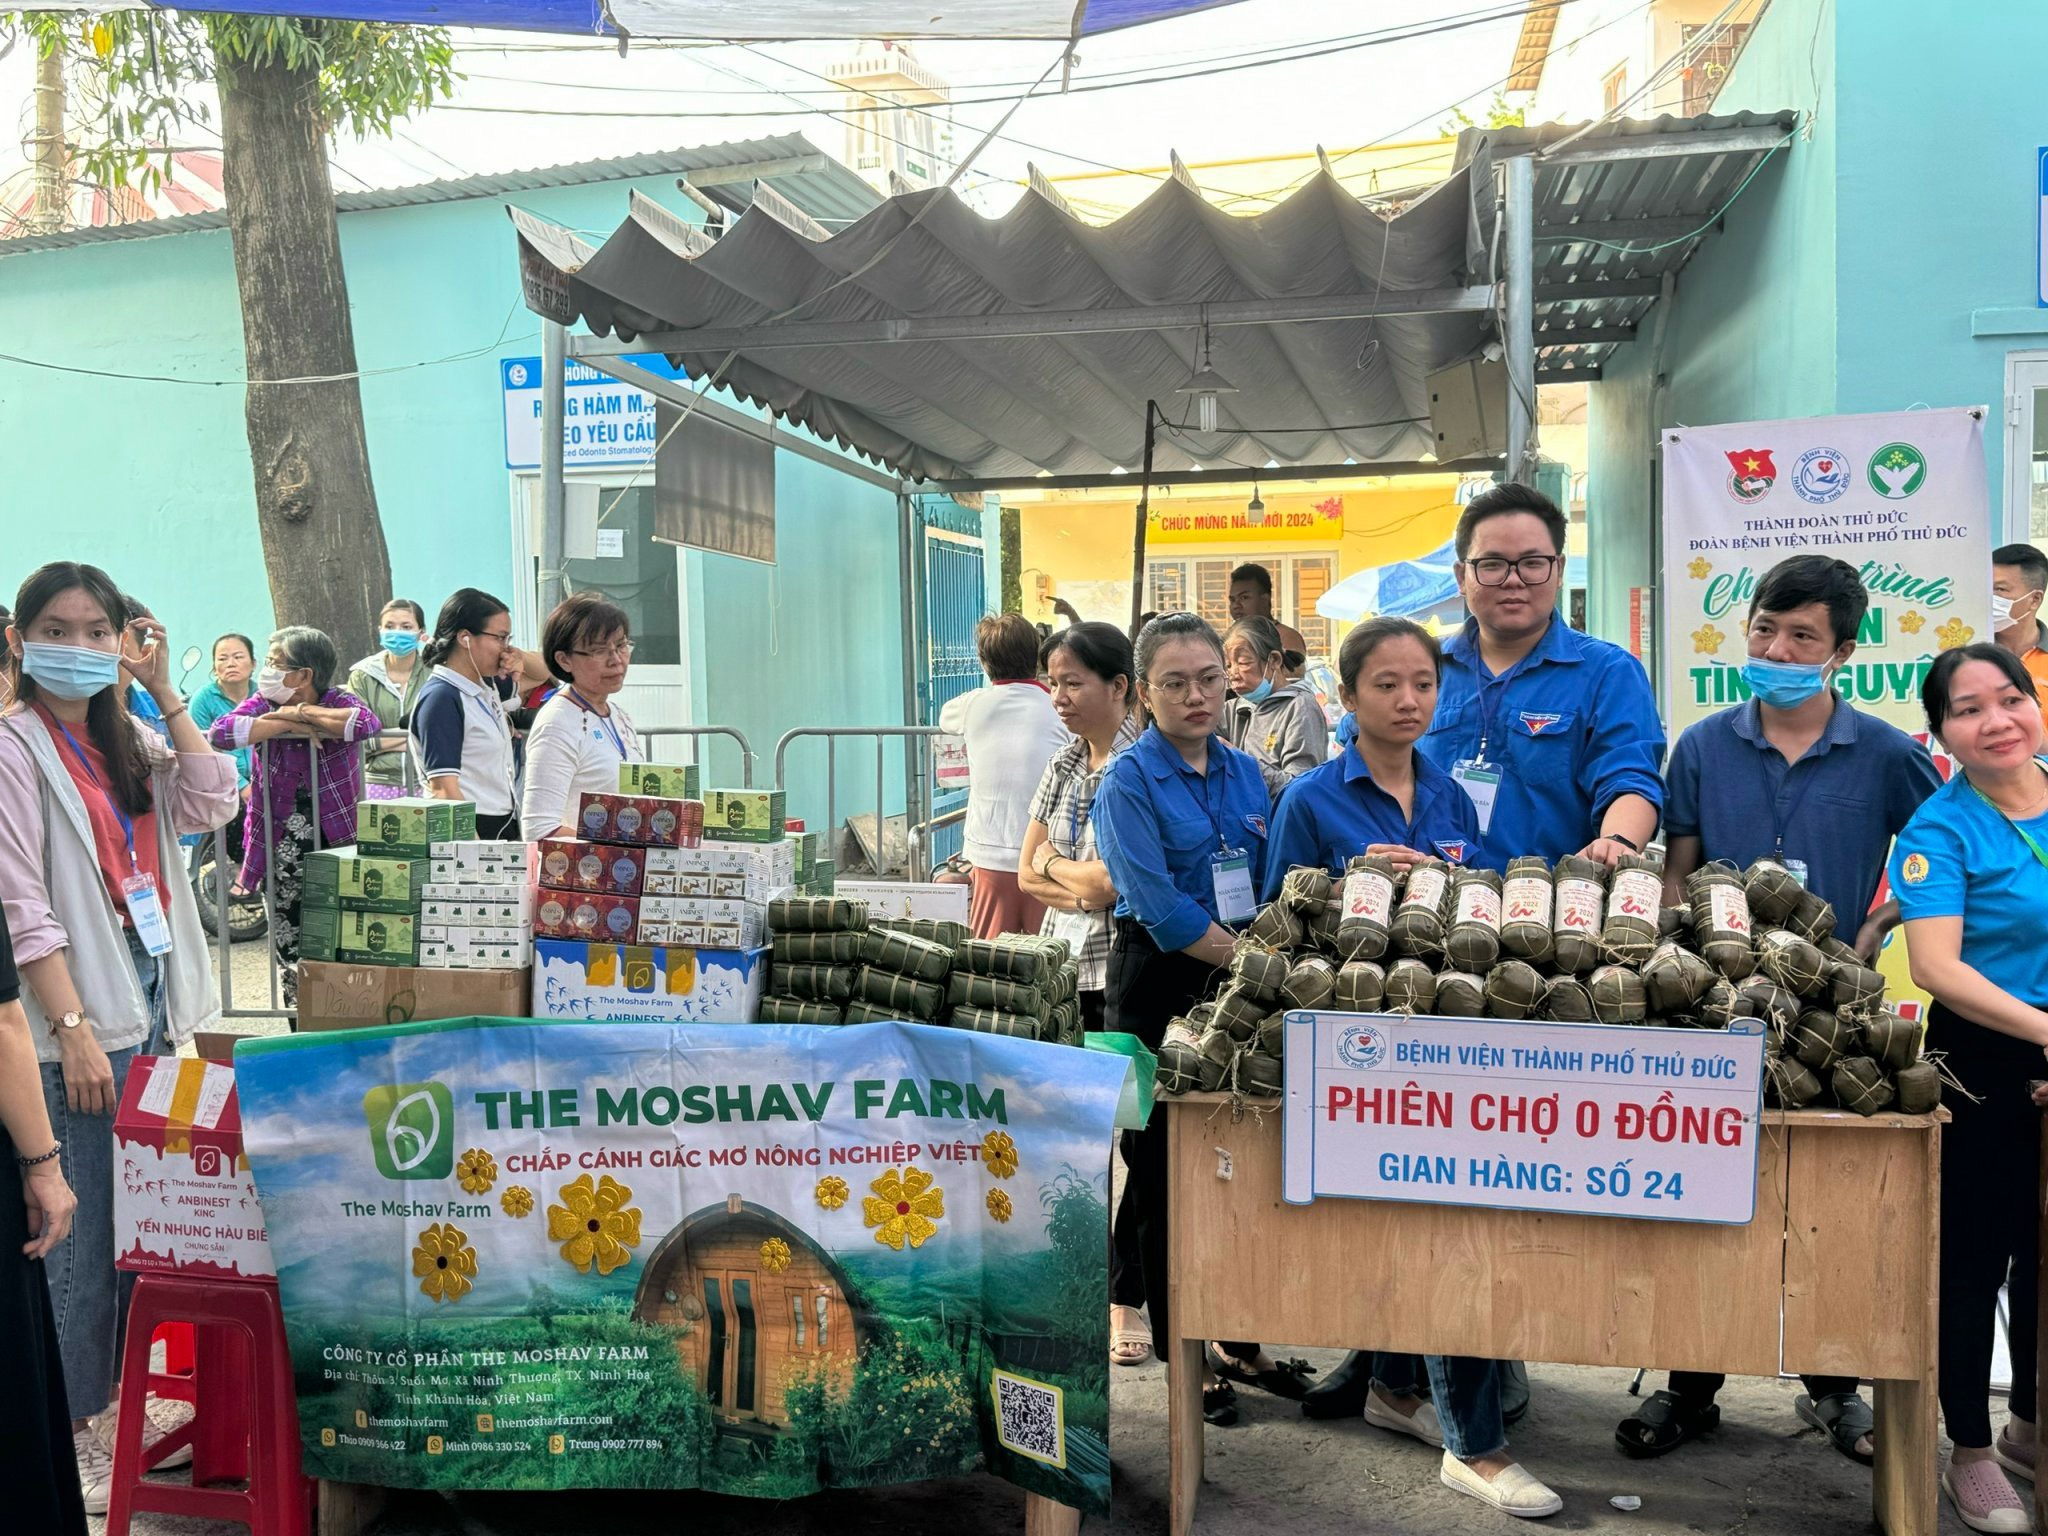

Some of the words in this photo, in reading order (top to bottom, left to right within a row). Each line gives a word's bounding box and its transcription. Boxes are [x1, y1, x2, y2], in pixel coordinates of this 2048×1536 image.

[565, 363, 598, 380] HÒNG
[584, 393, 621, 415] HÀM
[587, 421, 618, 443] YÊU
[624, 416, 656, 441] CẦU
[578, 447, 606, 456] Odonto
[1161, 513, 1191, 531] CHÚC
[1194, 511, 1228, 530] MỪNG
[1261, 510, 1283, 527] MỚI
[1286, 512, 1314, 527] 2024
[1744, 516, 1794, 531] THÀNH
[1799, 513, 1839, 528] ĐOÀN
[1842, 510, 1873, 526] THỦ
[1877, 509, 1908, 524] ĐỨC
[1689, 536, 1729, 551] ĐOÀN
[1732, 534, 1770, 551] BỆNH
[1776, 532, 1808, 549] VIỆN
[1812, 529, 1863, 545] THÀNH
[1867, 525, 1898, 542] PHỐ
[1901, 524, 1932, 540] THỦ
[1936, 523, 1967, 539] ĐỨC
[600, 997, 614, 1005] The
[616, 997, 649, 1006] Moshav
[651, 998, 673, 1006] Farm
[1396, 1039, 1450, 1067] BỆNH
[1458, 1041, 1504, 1068] VIỆN
[1512, 1042, 1583, 1073] THÀNH
[1591, 1047, 1637, 1075] PHỐ
[1642, 1050, 1685, 1078] THỦ
[1691, 1053, 1737, 1080] ĐỨC
[475, 1088, 580, 1130] THE
[596, 1082, 835, 1126] MOSHAV
[854, 1078, 1008, 1125] FARM
[1327, 1080, 1453, 1129] PHIÊN
[1470, 1091, 1559, 1144] CHỢ
[1614, 1089, 1743, 1147] ĐỒNG
[506, 1147, 571, 1173] CHẮP
[578, 1147, 642, 1169] CÁNH
[650, 1143, 701, 1168] GIẤC
[709, 1145, 747, 1167] MƠ
[755, 1143, 821, 1167] NÔNG
[829, 1140, 921, 1168] NGHIỆP
[928, 1139, 981, 1165] VIỆT
[171, 1179, 185, 1187] The
[187, 1180, 216, 1189] Moshav
[218, 1182, 237, 1190] Farm
[1378, 1152, 1456, 1186] GIAN
[1469, 1153, 1573, 1194] HÀNG:
[1585, 1157, 1634, 1196] SỐ
[1643, 1171, 1684, 1201] 24
[178, 1195, 230, 1208] ANBINEST
[341, 1201, 376, 1217] The
[382, 1200, 443, 1217] Moshav
[448, 1202, 491, 1218] Farm
[194, 1209, 215, 1218] KING
[136, 1217, 160, 1233] YẾN
[164, 1223, 211, 1238] NHUNG
[215, 1225, 242, 1240] HÀU
[184, 1242, 208, 1250] CHƯNG
[323, 1344, 362, 1362] CÔNG
[366, 1351, 382, 1365] TY
[387, 1349, 407, 1367] CỔ
[414, 1348, 463, 1367] PHẦN
[471, 1352, 506, 1366] THE
[513, 1347, 591, 1364] MOSHAV
[598, 1346, 649, 1360] FARM
[324, 1369, 342, 1381] Địa
[362, 1373, 385, 1385] Thôn
[401, 1374, 426, 1386] Suối
[455, 1375, 468, 1386] Xã
[473, 1374, 503, 1386] Ninh
[590, 1370, 621, 1381] Ninh
[627, 1369, 650, 1380] Hòa
[426, 1393, 463, 1405] Khánh
[467, 1394, 491, 1406] Hòa,
[495, 1394, 520, 1405] Việt
[526, 1392, 554, 1402] Nam
[369, 1416, 448, 1428] themoshavfarm
[496, 1414, 613, 1429] themoshavfarm.com
[446, 1442, 470, 1451] Minh
[471, 1441, 494, 1451] 0986
[495, 1441, 512, 1451] 330
[514, 1441, 531, 1451] 524
[569, 1439, 600, 1450] Trang
[602, 1439, 625, 1449] 0902
[627, 1438, 645, 1449] 777
[646, 1439, 663, 1449] 894
